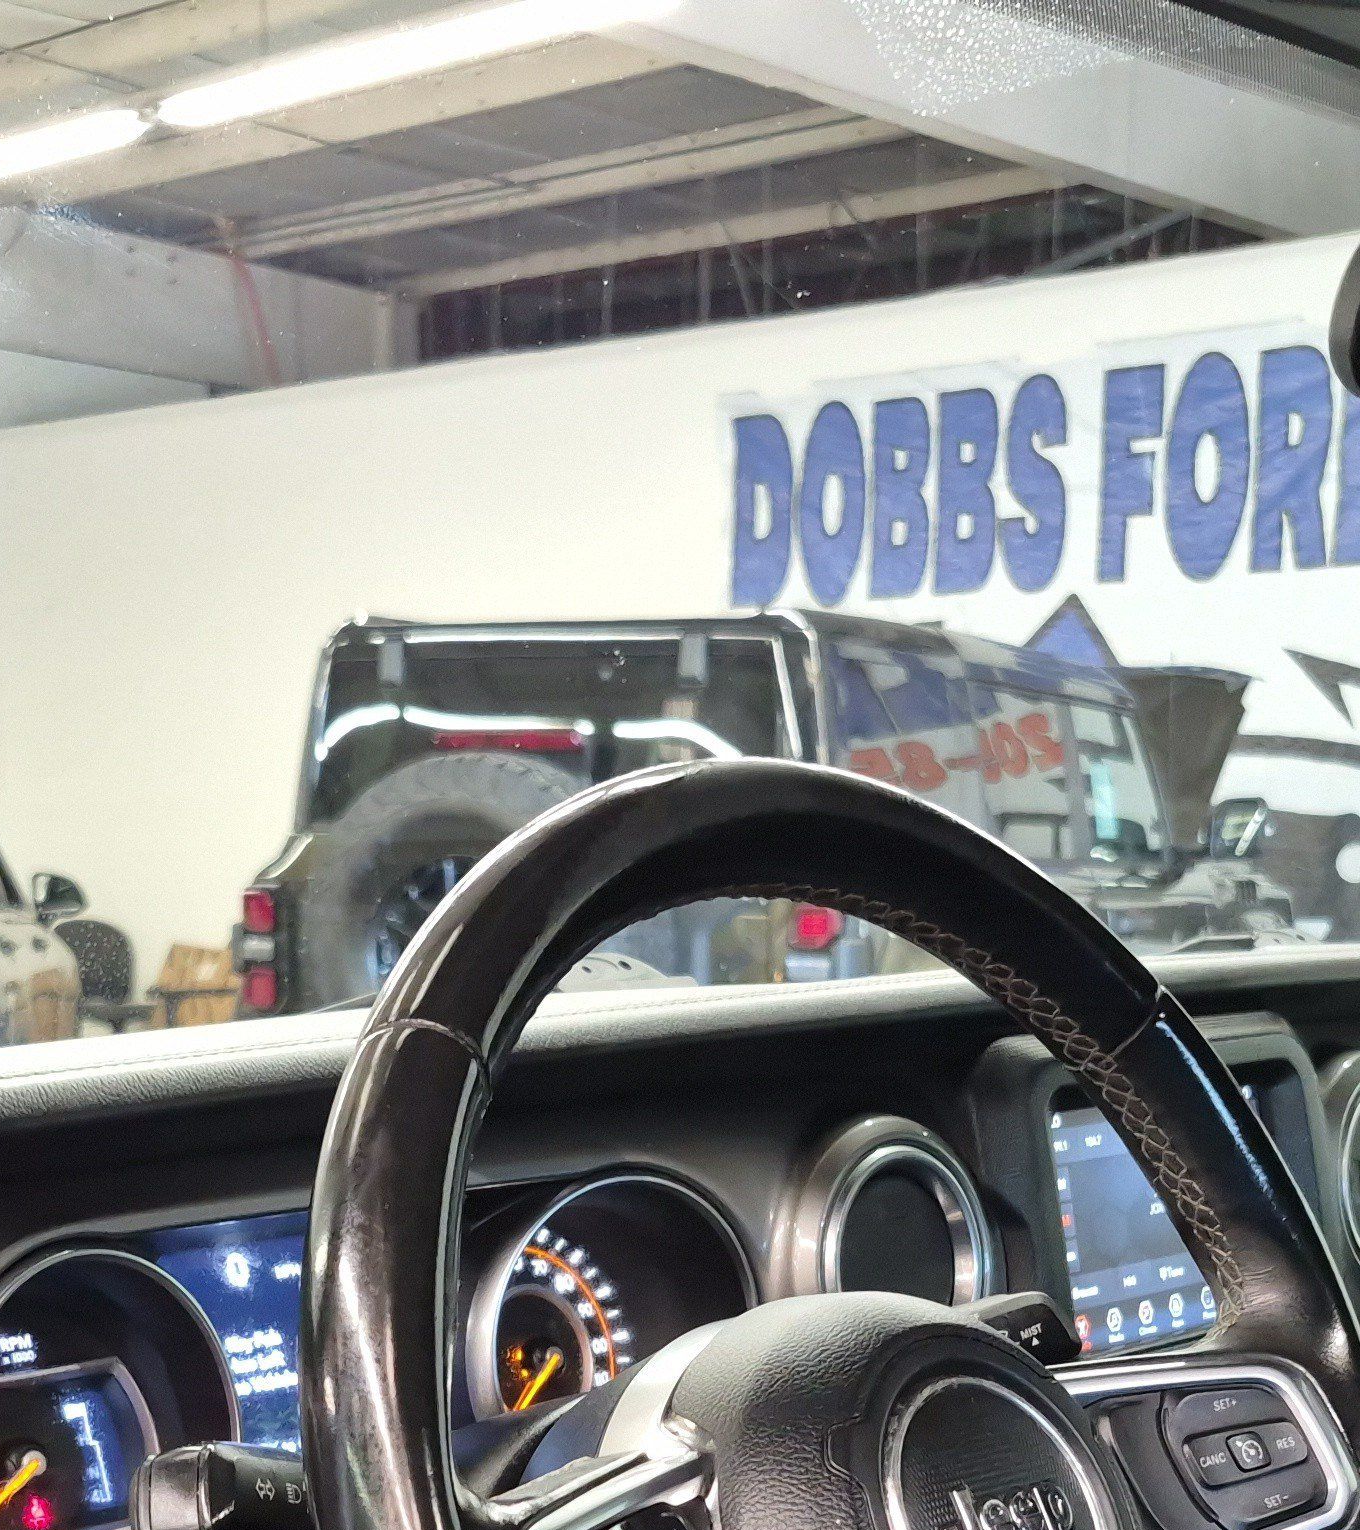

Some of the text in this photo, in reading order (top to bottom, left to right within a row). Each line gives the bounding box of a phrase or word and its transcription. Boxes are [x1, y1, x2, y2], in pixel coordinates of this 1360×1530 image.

[731, 373, 1068, 607] DOBBS
[1019, 1322, 1042, 1341] MIST
[1275, 1436, 1296, 1450] RES
[1199, 1451, 1227, 1468] CANC
